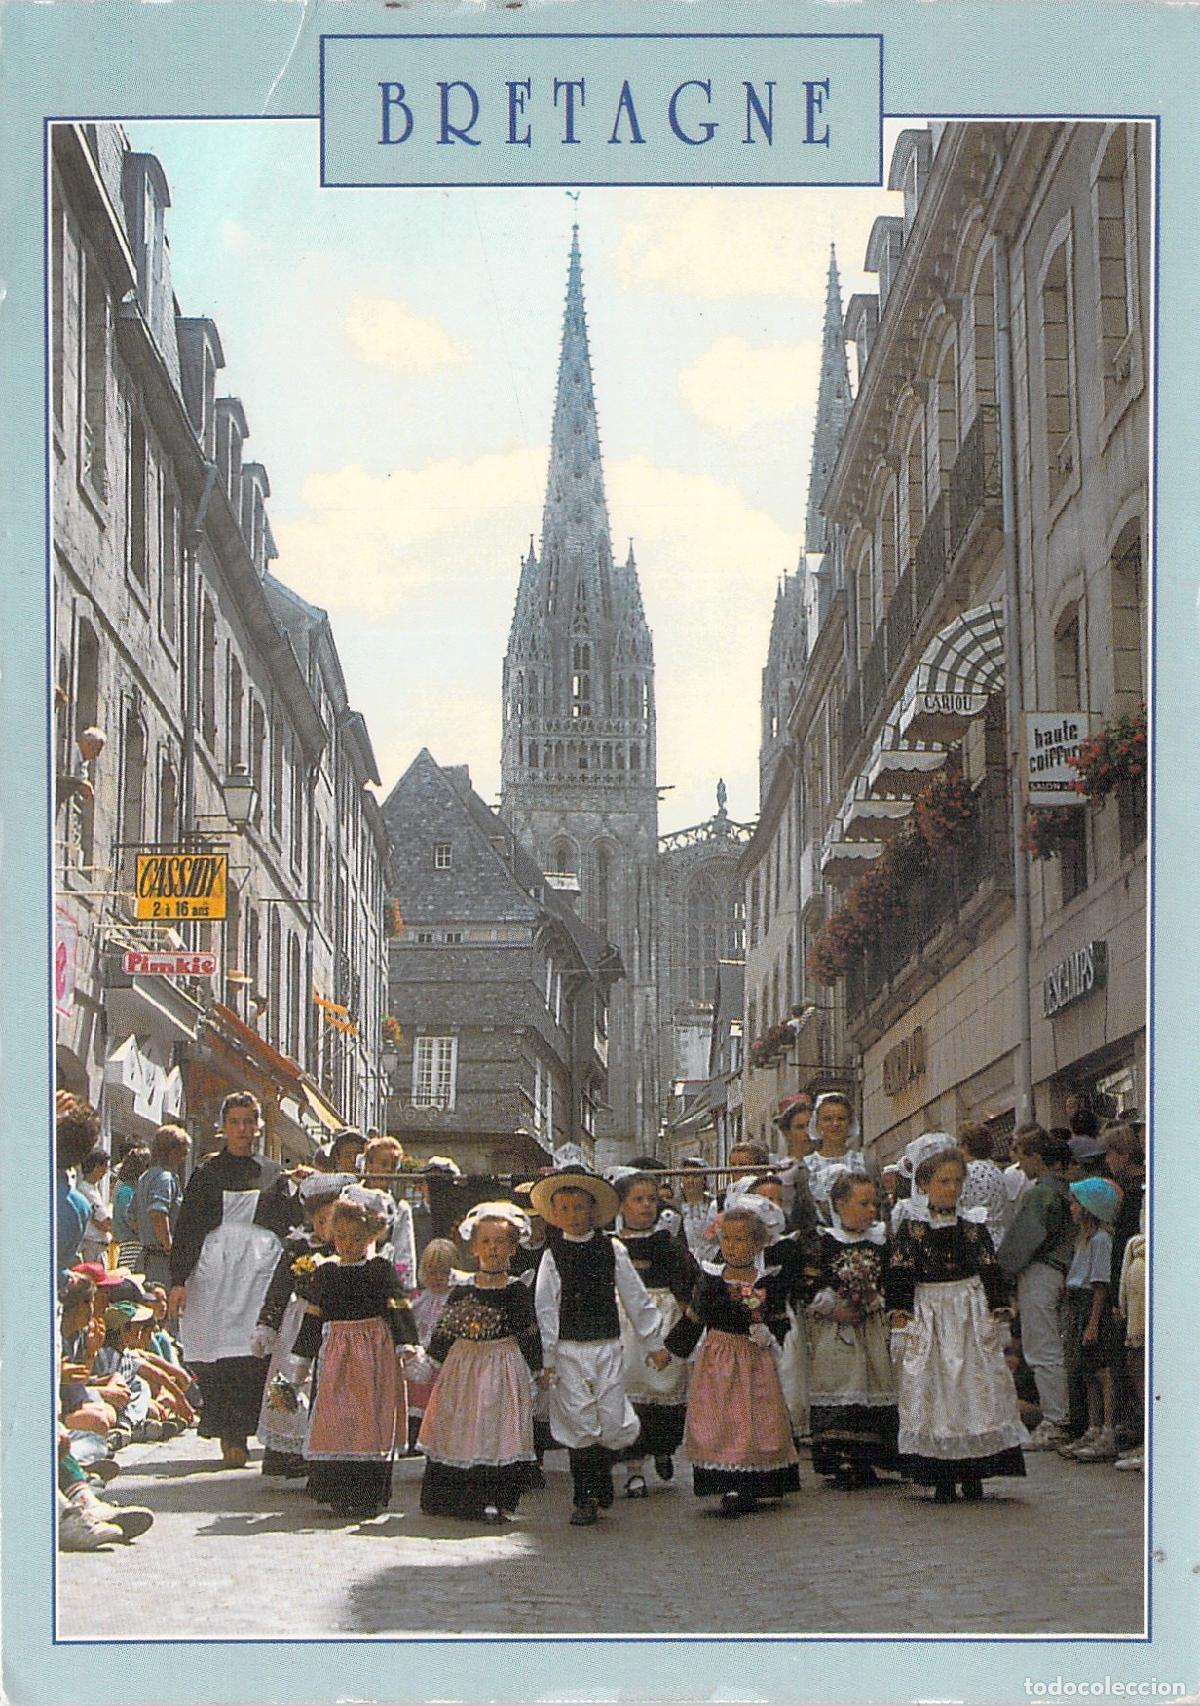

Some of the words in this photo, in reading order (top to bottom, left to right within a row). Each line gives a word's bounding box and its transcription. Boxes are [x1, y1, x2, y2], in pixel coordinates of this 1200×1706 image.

[924, 694, 972, 711] CARIOU
[1034, 720, 1078, 749] haute
[140, 857, 224, 898] CASSIDY
[153, 901, 162, 917] 2
[175, 901, 189, 917] 16
[192, 905, 209, 917] ans
[128, 952, 214, 975] Pimkie
